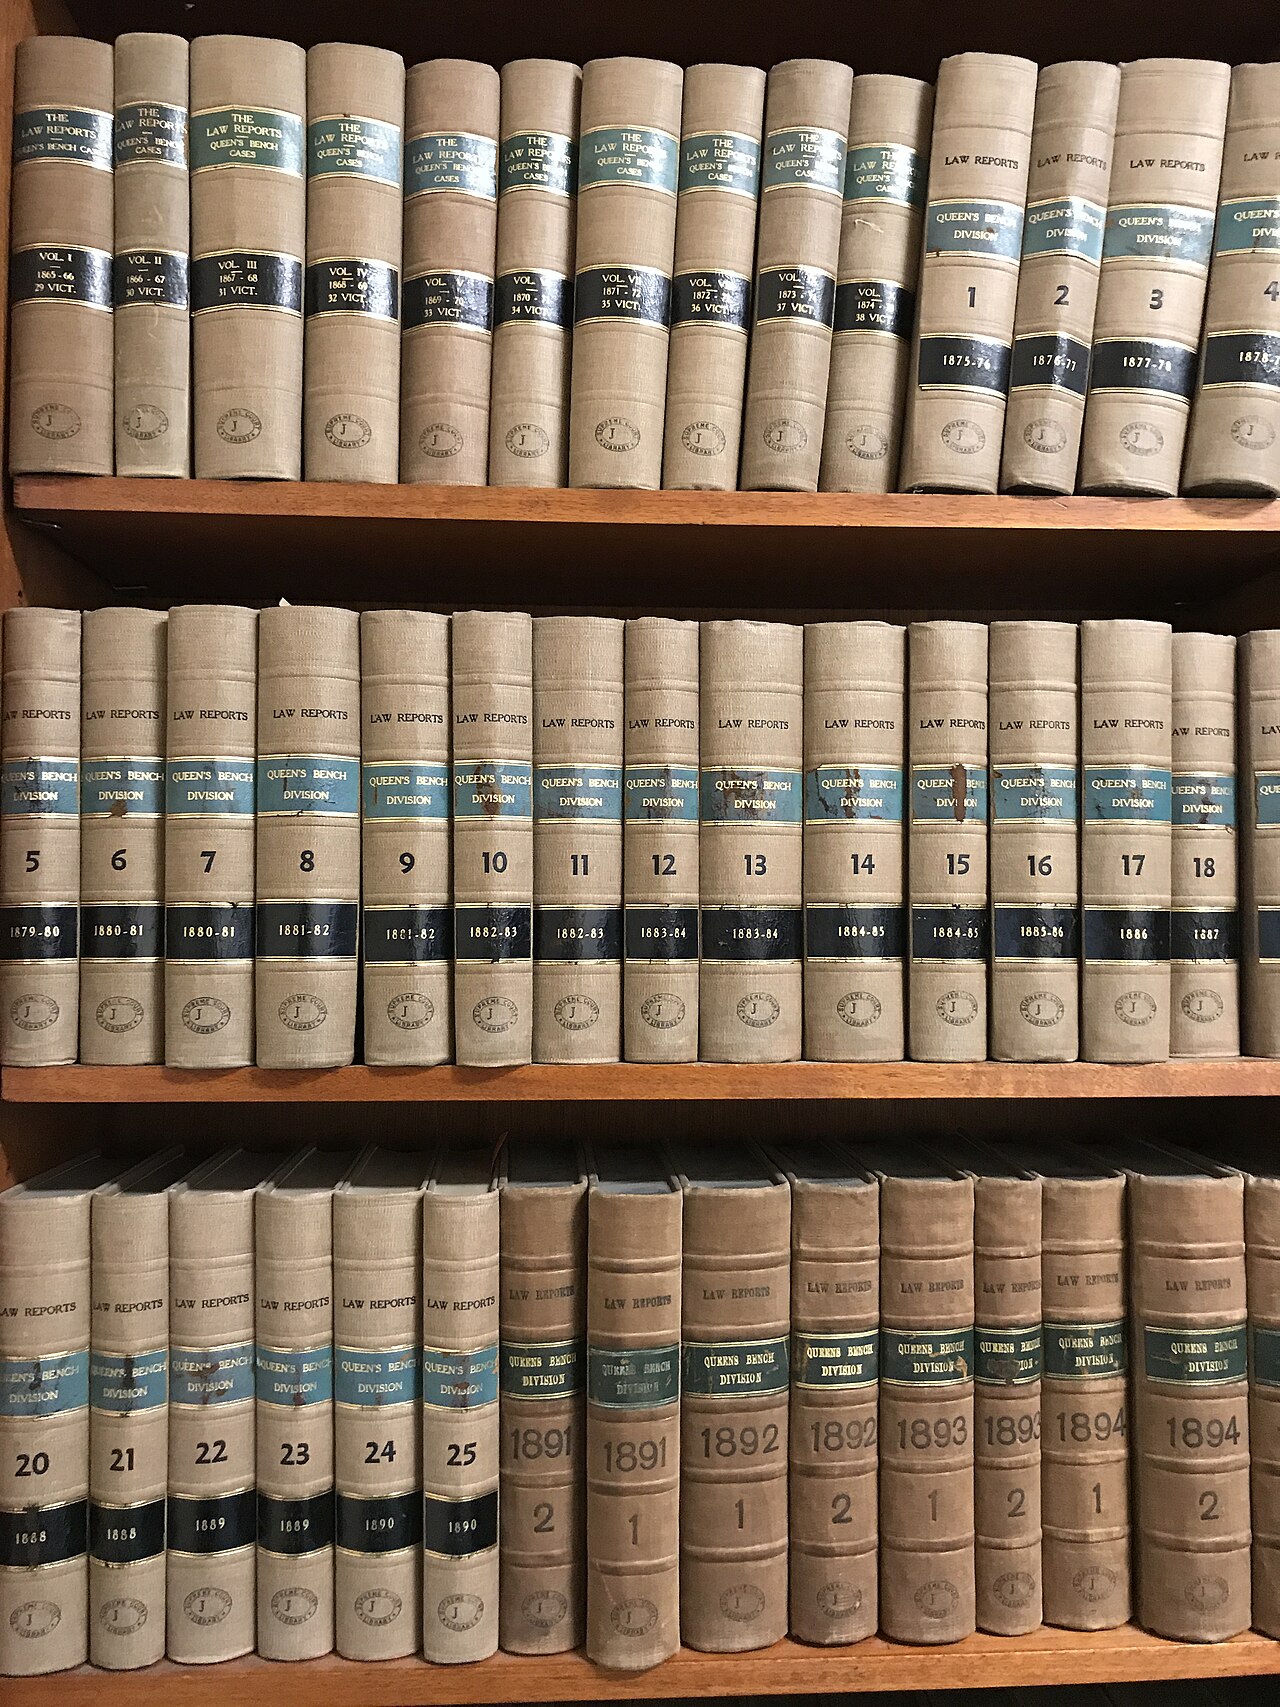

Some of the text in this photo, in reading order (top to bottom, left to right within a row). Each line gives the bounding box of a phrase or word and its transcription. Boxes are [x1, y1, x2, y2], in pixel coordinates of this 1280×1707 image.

[45, 113, 69, 123] THE
[138, 108, 159, 117] THE
[231, 114, 254, 124] THE
[22, 126, 97, 138] LAW REPORTS
[206, 125, 282, 138] LAW REPORTS
[339, 123, 361, 133] THE
[436, 138, 458, 146] THE
[621, 133, 642, 142] THE
[210, 139, 279, 150] QUEEN'S BENCH
[135, 147, 162, 155] CASES
[229, 150, 257, 158] CASES
[317, 148, 351, 158] QUEEN'S
[336, 159, 363, 167] CASES
[597, 157, 631, 166] QUEEN'S
[945, 156, 1019, 170] LAW REPORTS
[1129, 159, 1205, 172] LAW REPORTS
[617, 168, 642, 176] CASES
[937, 212, 979, 222] QUEEN'S
[1118, 218, 1163, 228] QUEEN'S
[954, 230, 998, 241] DIVISION
[1137, 234, 1182, 246] DIVISION
[39, 252, 72, 262] VOL. I
[128, 256, 162, 265] VOL. II
[218, 260, 257, 270] VOL. III
[425, 278, 447, 286] VOL.
[602, 274, 625, 283] VOL.
[689, 279, 712, 287] VOL.
[34, 283, 77, 293] 29 VICT.
[219, 286, 258, 296] 31 VICT.
[967, 286, 977, 308] 1
[1053, 284, 1070, 306] 2
[1150, 288, 1164, 310] 3
[602, 300, 610, 308] 35
[691, 303, 700, 312] 36
[777, 303, 786, 312] 37
[855, 313, 865, 322] 38
[942, 355, 991, 370] 1875-76
[1033, 354, 1077, 372] 1876-77
[1123, 356, 1172, 372] 1877-78
[86, 710, 160, 720] LAW REPORTS
[173, 710, 248, 721] LAW REPORTS
[273, 709, 348, 720] LAW REPORTS
[370, 714, 444, 723] LAW REPORTS
[456, 714, 528, 724] LAW REPORTS
[542, 719, 615, 728] LAW REPORTS
[629, 719, 695, 729] LAW REPORTS
[718, 720, 789, 730] LAW REPORTS
[824, 720, 895, 729] LAW REPORTS
[920, 719, 986, 729] LAW REPORTS
[999, 720, 1070, 730] LAW REPORTS
[1094, 720, 1164, 729] LAW REPORTS
[267, 769, 347, 780] QUEEN'S BENCH
[369, 776, 448, 786] QUEEN'S BENCH
[821, 779, 896, 789] QUEEN'S BENCH
[1092, 780, 1167, 790] QUEEN'S BENCH
[283, 790, 329, 800] DIVISION
[387, 796, 431, 805] DIVISION
[840, 798, 883, 808] DIVISION
[1112, 799, 1154, 808] DIVISION
[26, 851, 40, 872] 5
[112, 849, 127, 870] 6
[200, 851, 216, 873] 7
[300, 850, 315, 872] 8
[399, 852, 415, 874] 9
[482, 852, 507, 873] 10
[571, 855, 589, 875] 11
[652, 855, 677, 875] 12
[744, 854, 767, 875] 13
[851, 854, 875, 874] 14
[947, 854, 970, 875] 15
[1028, 855, 1052, 876] 16
[1122, 855, 1145, 875] 17
[1193, 858, 1215, 877] 18
[10, 926, 60, 938] 1879-80
[94, 925, 143, 936] 1880-81
[183, 927, 234, 937] 1880-81
[279, 925, 329, 936] 1881-82
[470, 927, 517, 938] 1882-83
[557, 928, 604, 939] 1882-83
[641, 928, 686, 938] 1883-84
[732, 928, 778, 939] 1883-84
[838, 926, 885, 937] 1884-85
[933, 927, 978, 938] 1884-85
[1020, 926, 1064, 938] 1885-86
[1120, 928, 1148, 939] 1886
[1194, 929, 1219, 940] 1887
[175, 1294, 249, 1308] LAW REPORTS
[343, 1296, 416, 1310] LAW REPORTS
[806, 1344, 873, 1359] QUEENS BENCH
[704, 1352, 774, 1368] QUEENS BENCH
[821, 1364, 862, 1377] DIVISION
[720, 1372, 762, 1386] DIVISION
[1056, 1407, 1127, 1442] 1894
[811, 1417, 876, 1452] 1892
[898, 1416, 968, 1449] 1893
[1166, 1415, 1240, 1448] 1894
[511, 1426, 572, 1460] 1891
[701, 1423, 779, 1458] 1892
[195, 1440, 228, 1464] 22
[280, 1443, 310, 1465] 23
[365, 1440, 396, 1463] 24
[447, 1442, 477, 1466] 25
[604, 1436, 667, 1472] 1891
[15, 1452, 50, 1477] 20
[110, 1448, 135, 1472] 21
[1008, 1488, 1025, 1518] 2
[1092, 1482, 1101, 1514] 1
[831, 1493, 852, 1524] 2
[928, 1489, 938, 1521] 1
[1200, 1491, 1220, 1521] 2
[533, 1502, 554, 1533] 2
[735, 1499, 744, 1529] 1
[196, 1517, 225, 1531] 1889
[280, 1519, 309, 1532] 1889
[365, 1518, 394, 1531] 1890
[449, 1519, 477, 1532] 1890
[629, 1514, 638, 1545] 1
[16, 1531, 47, 1544] 1888
[107, 1528, 137, 1540] 1888
